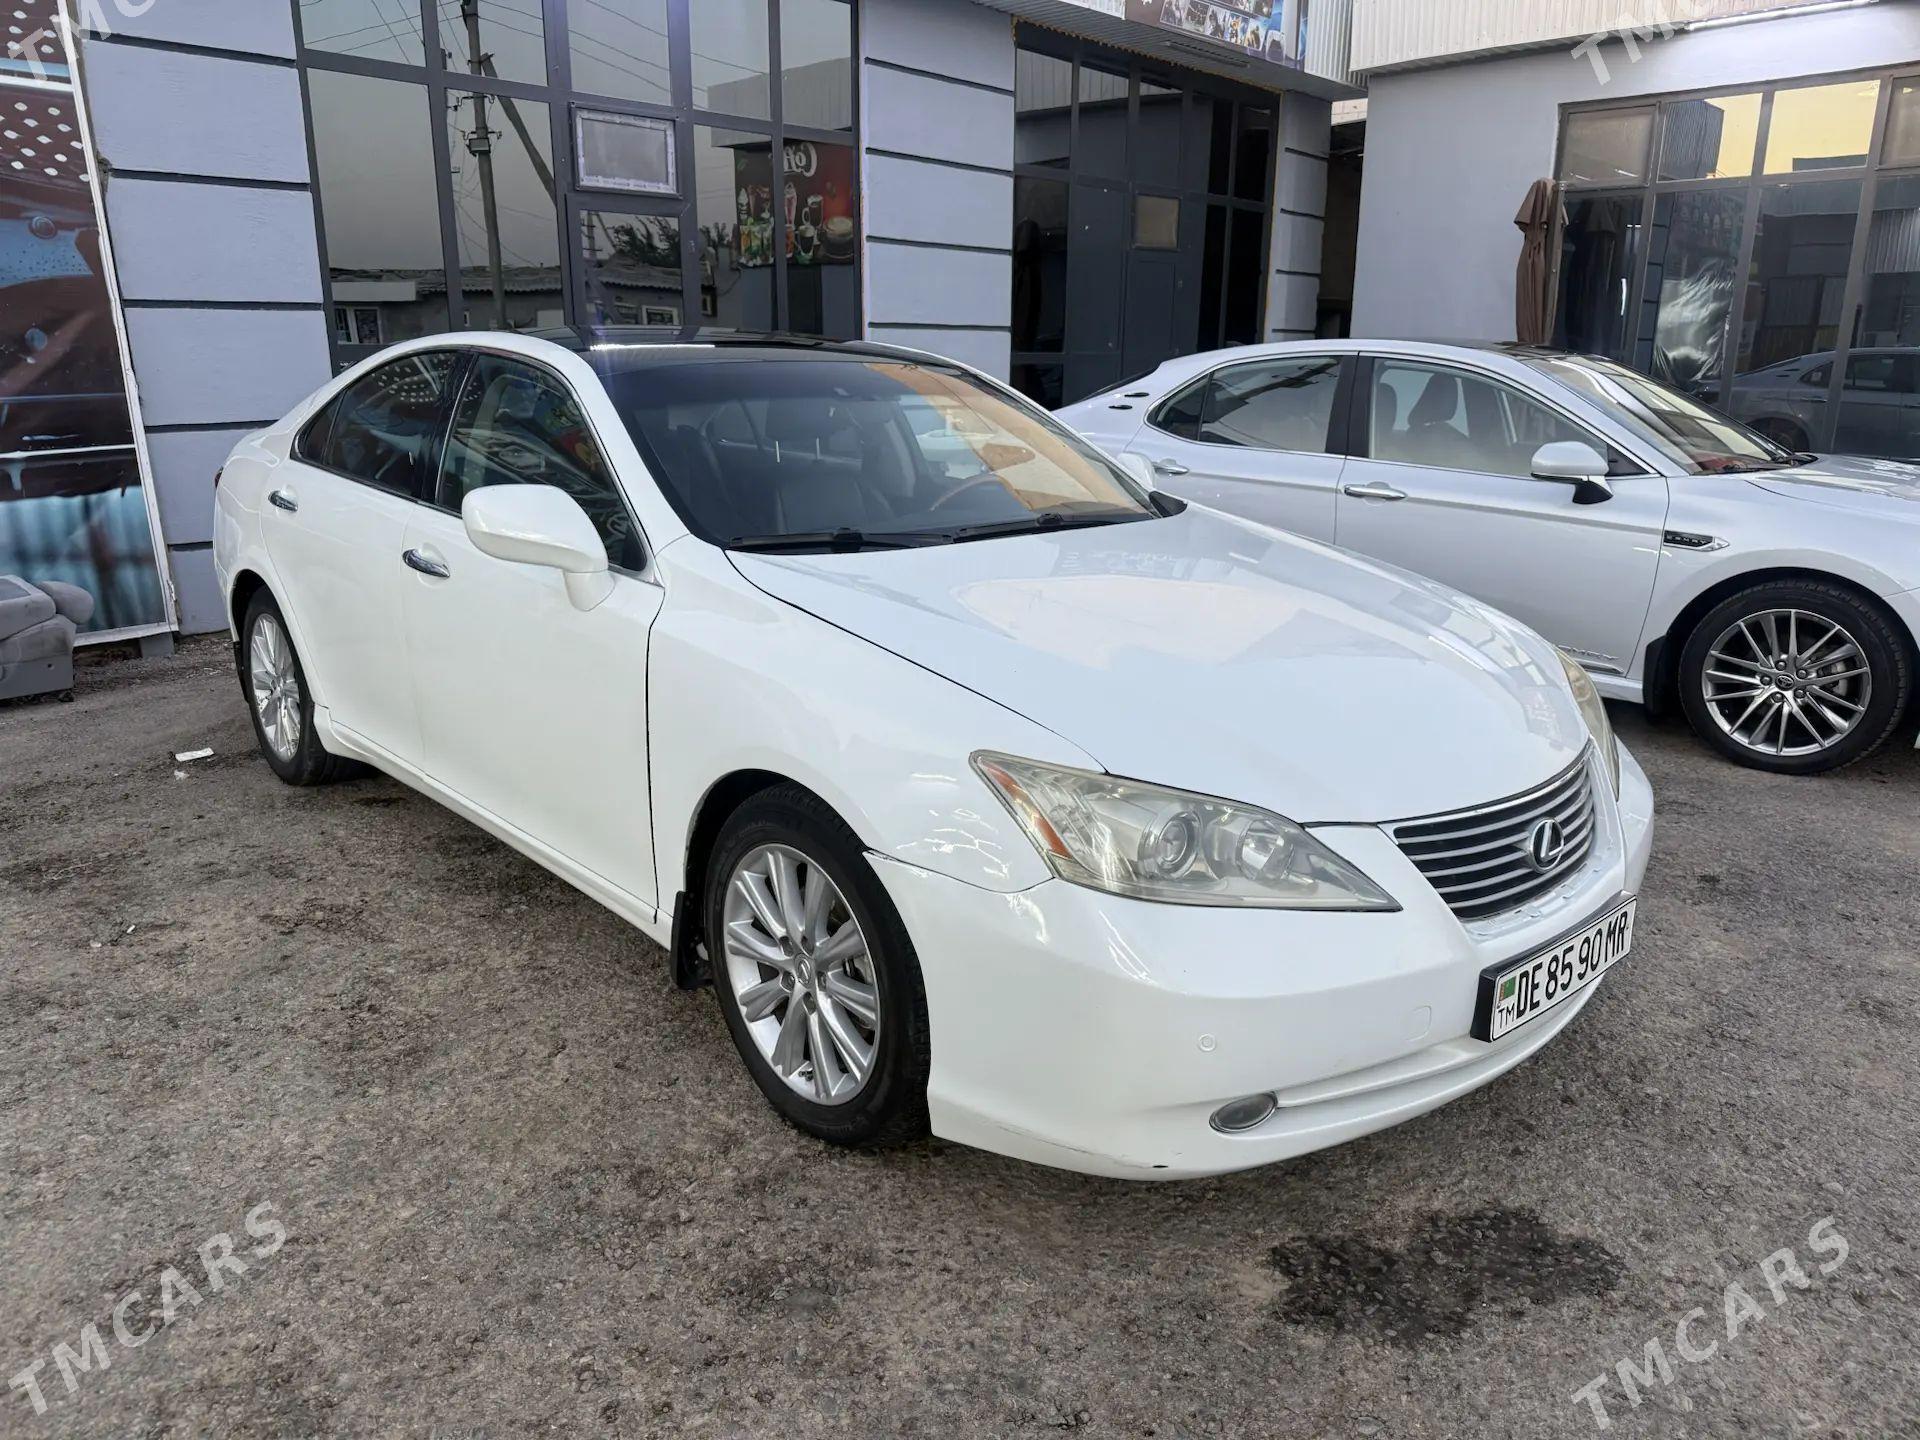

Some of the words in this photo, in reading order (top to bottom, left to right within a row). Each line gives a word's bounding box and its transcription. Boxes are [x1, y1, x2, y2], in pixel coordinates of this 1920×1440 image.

[1516, 962, 1543, 1019] DE
[1545, 944, 1574, 1000] 85
[1577, 928, 1602, 980] 90
[1604, 910, 1628, 963] MR
[1498, 1003, 1515, 1028] TM
